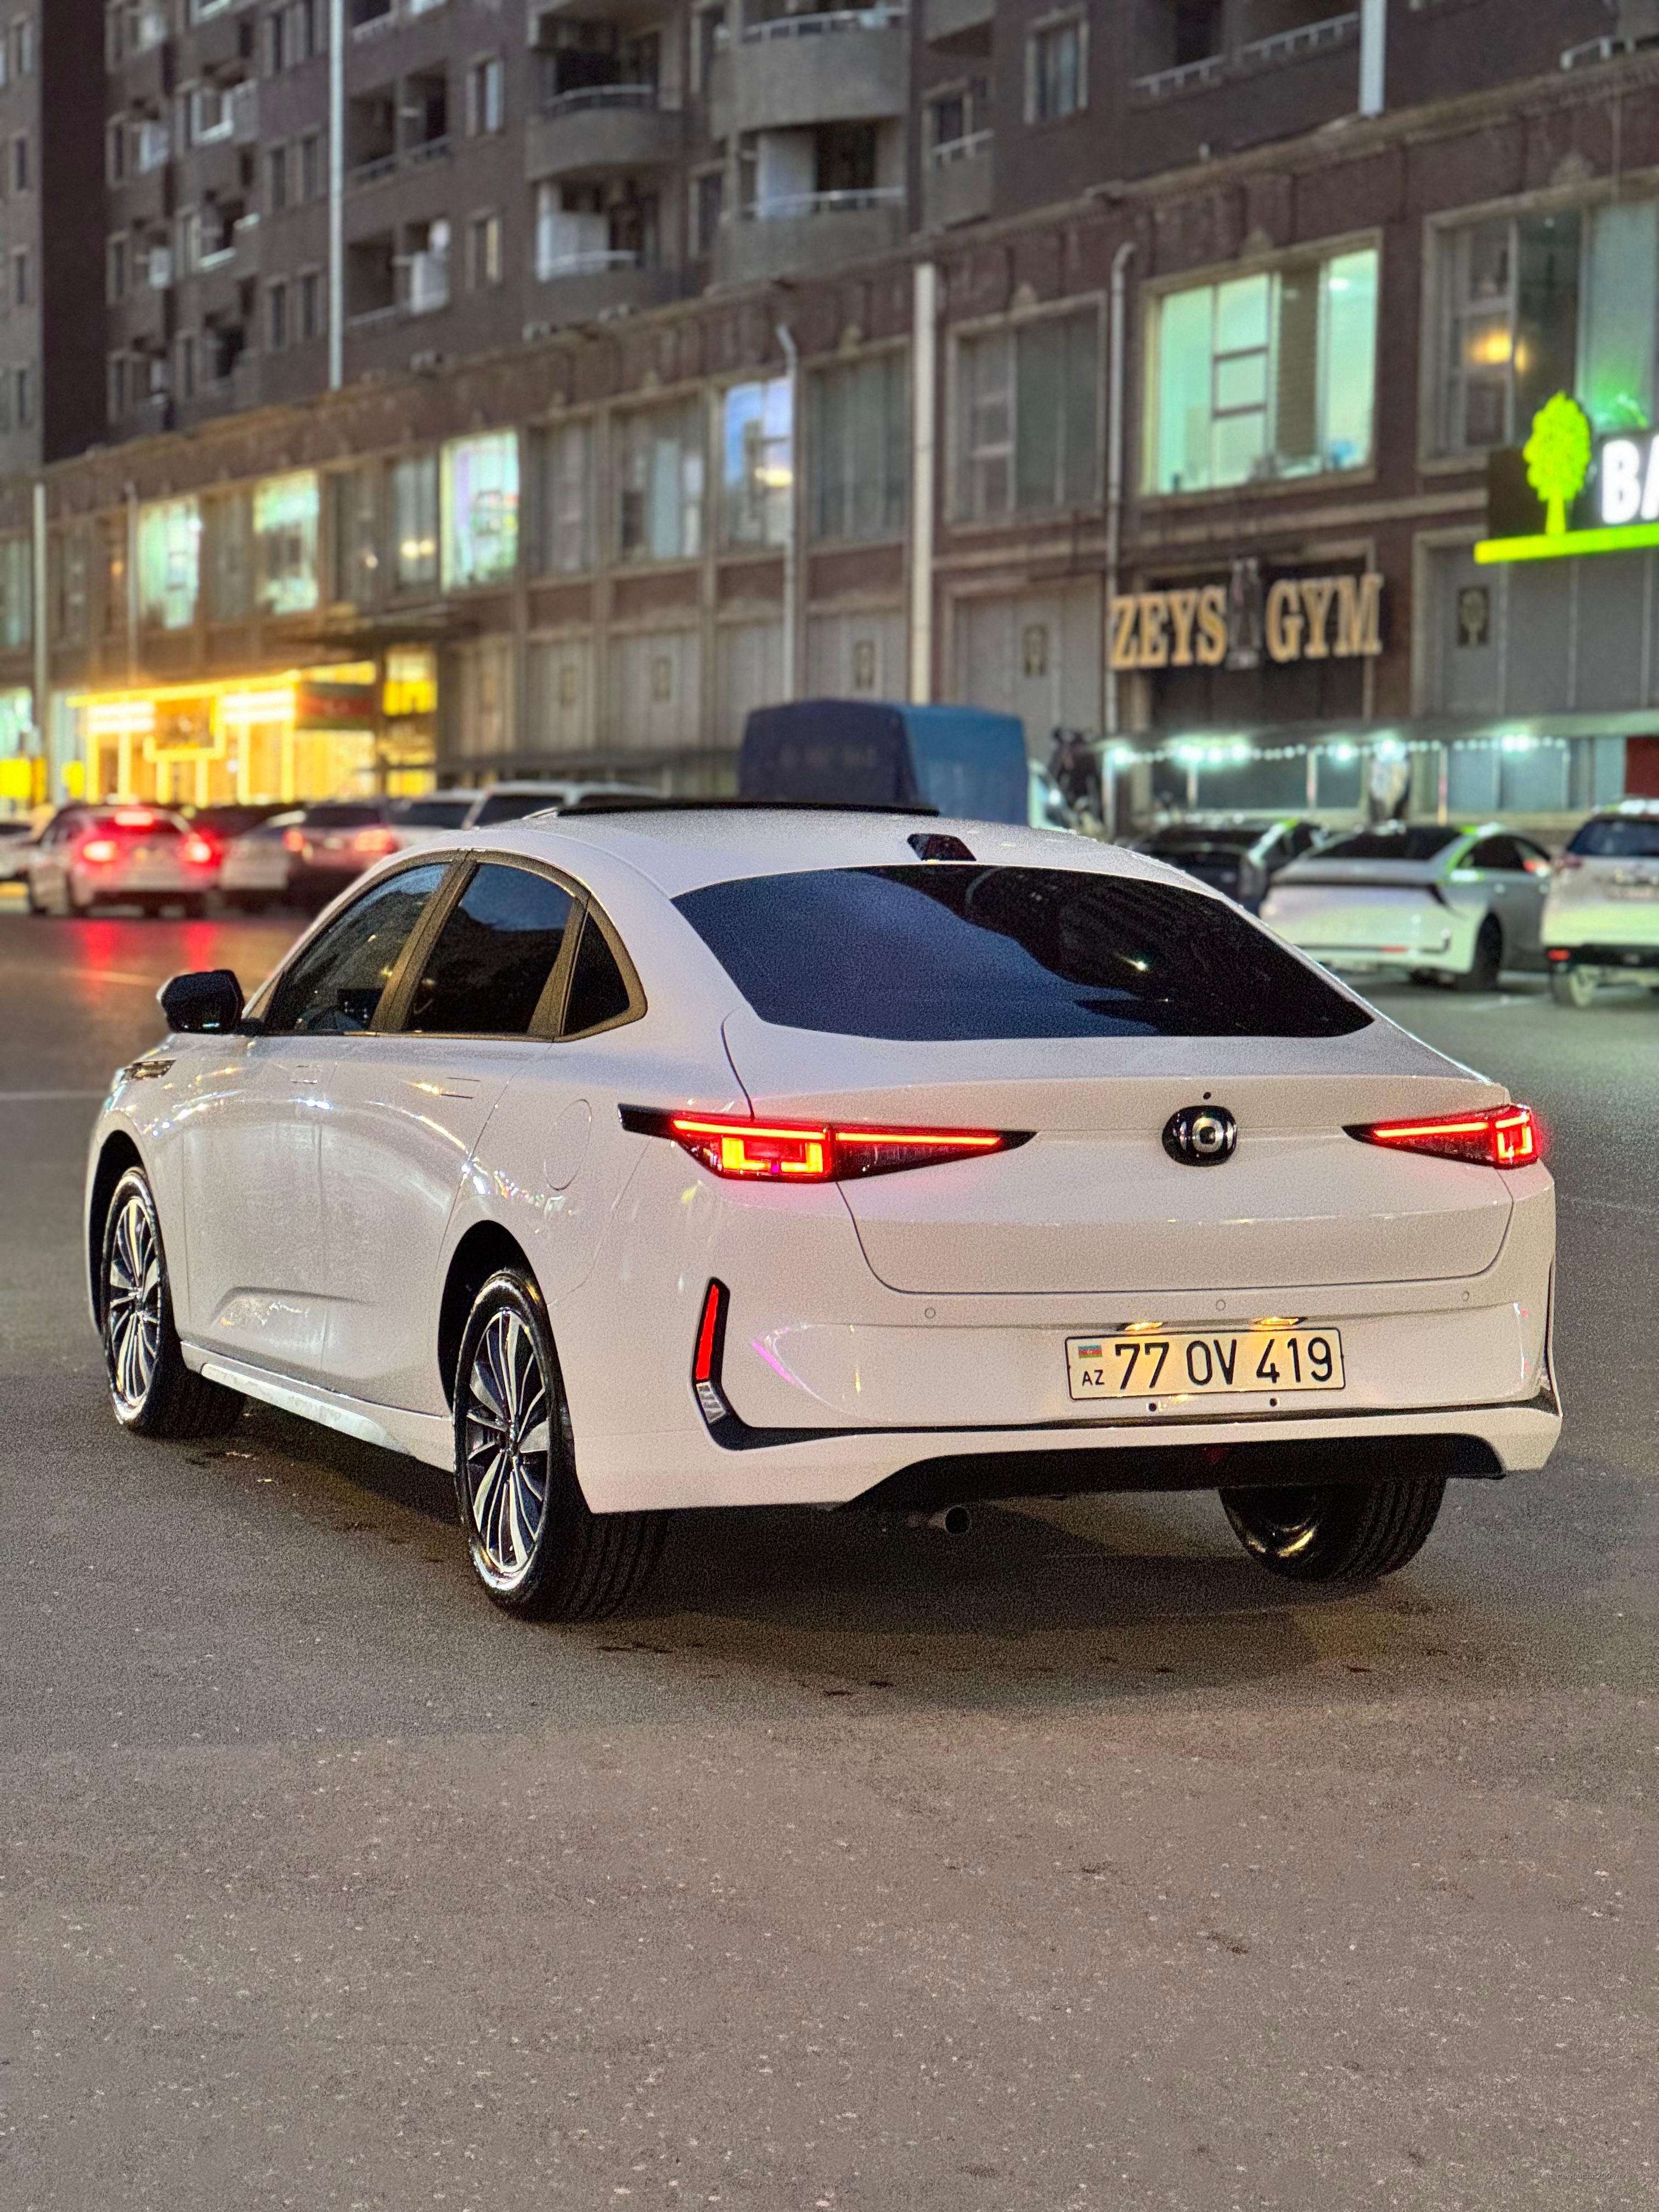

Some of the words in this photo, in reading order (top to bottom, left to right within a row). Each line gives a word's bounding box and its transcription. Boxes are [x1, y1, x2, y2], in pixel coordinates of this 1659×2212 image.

[1110, 585, 1228, 670] ZEYS
[1265, 573, 1384, 663] GYM
[1081, 1369, 1105, 1387] AZ
[1115, 1342, 1170, 1390] 77
[1186, 1339, 1237, 1385] OV
[1256, 1336, 1333, 1383] 419
